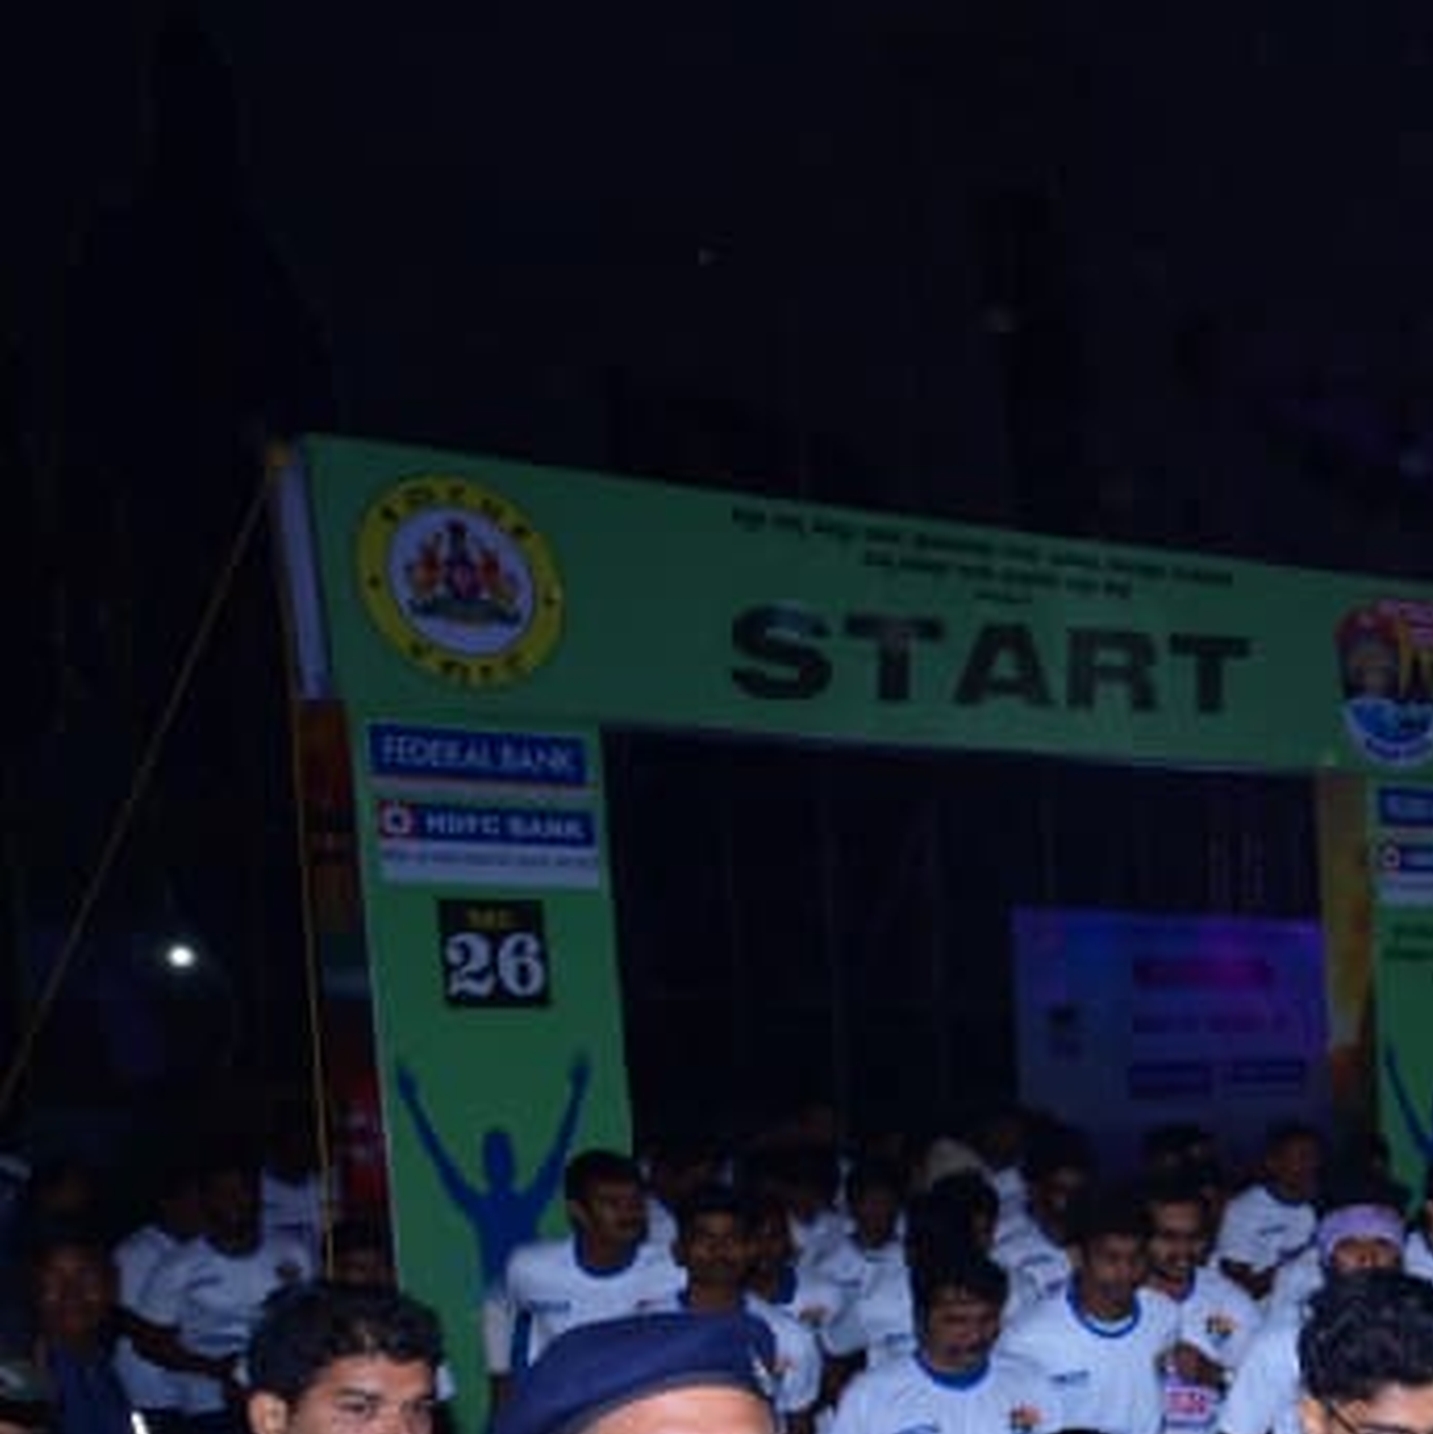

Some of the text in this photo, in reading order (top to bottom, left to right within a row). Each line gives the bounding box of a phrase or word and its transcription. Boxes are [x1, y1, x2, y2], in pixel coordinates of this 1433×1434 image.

[732, 601, 1250, 713] START
[381, 734, 577, 776] FEDERAL BANK
[425, 811, 586, 841] HDFC BANK
[446, 930, 546, 999] 26
